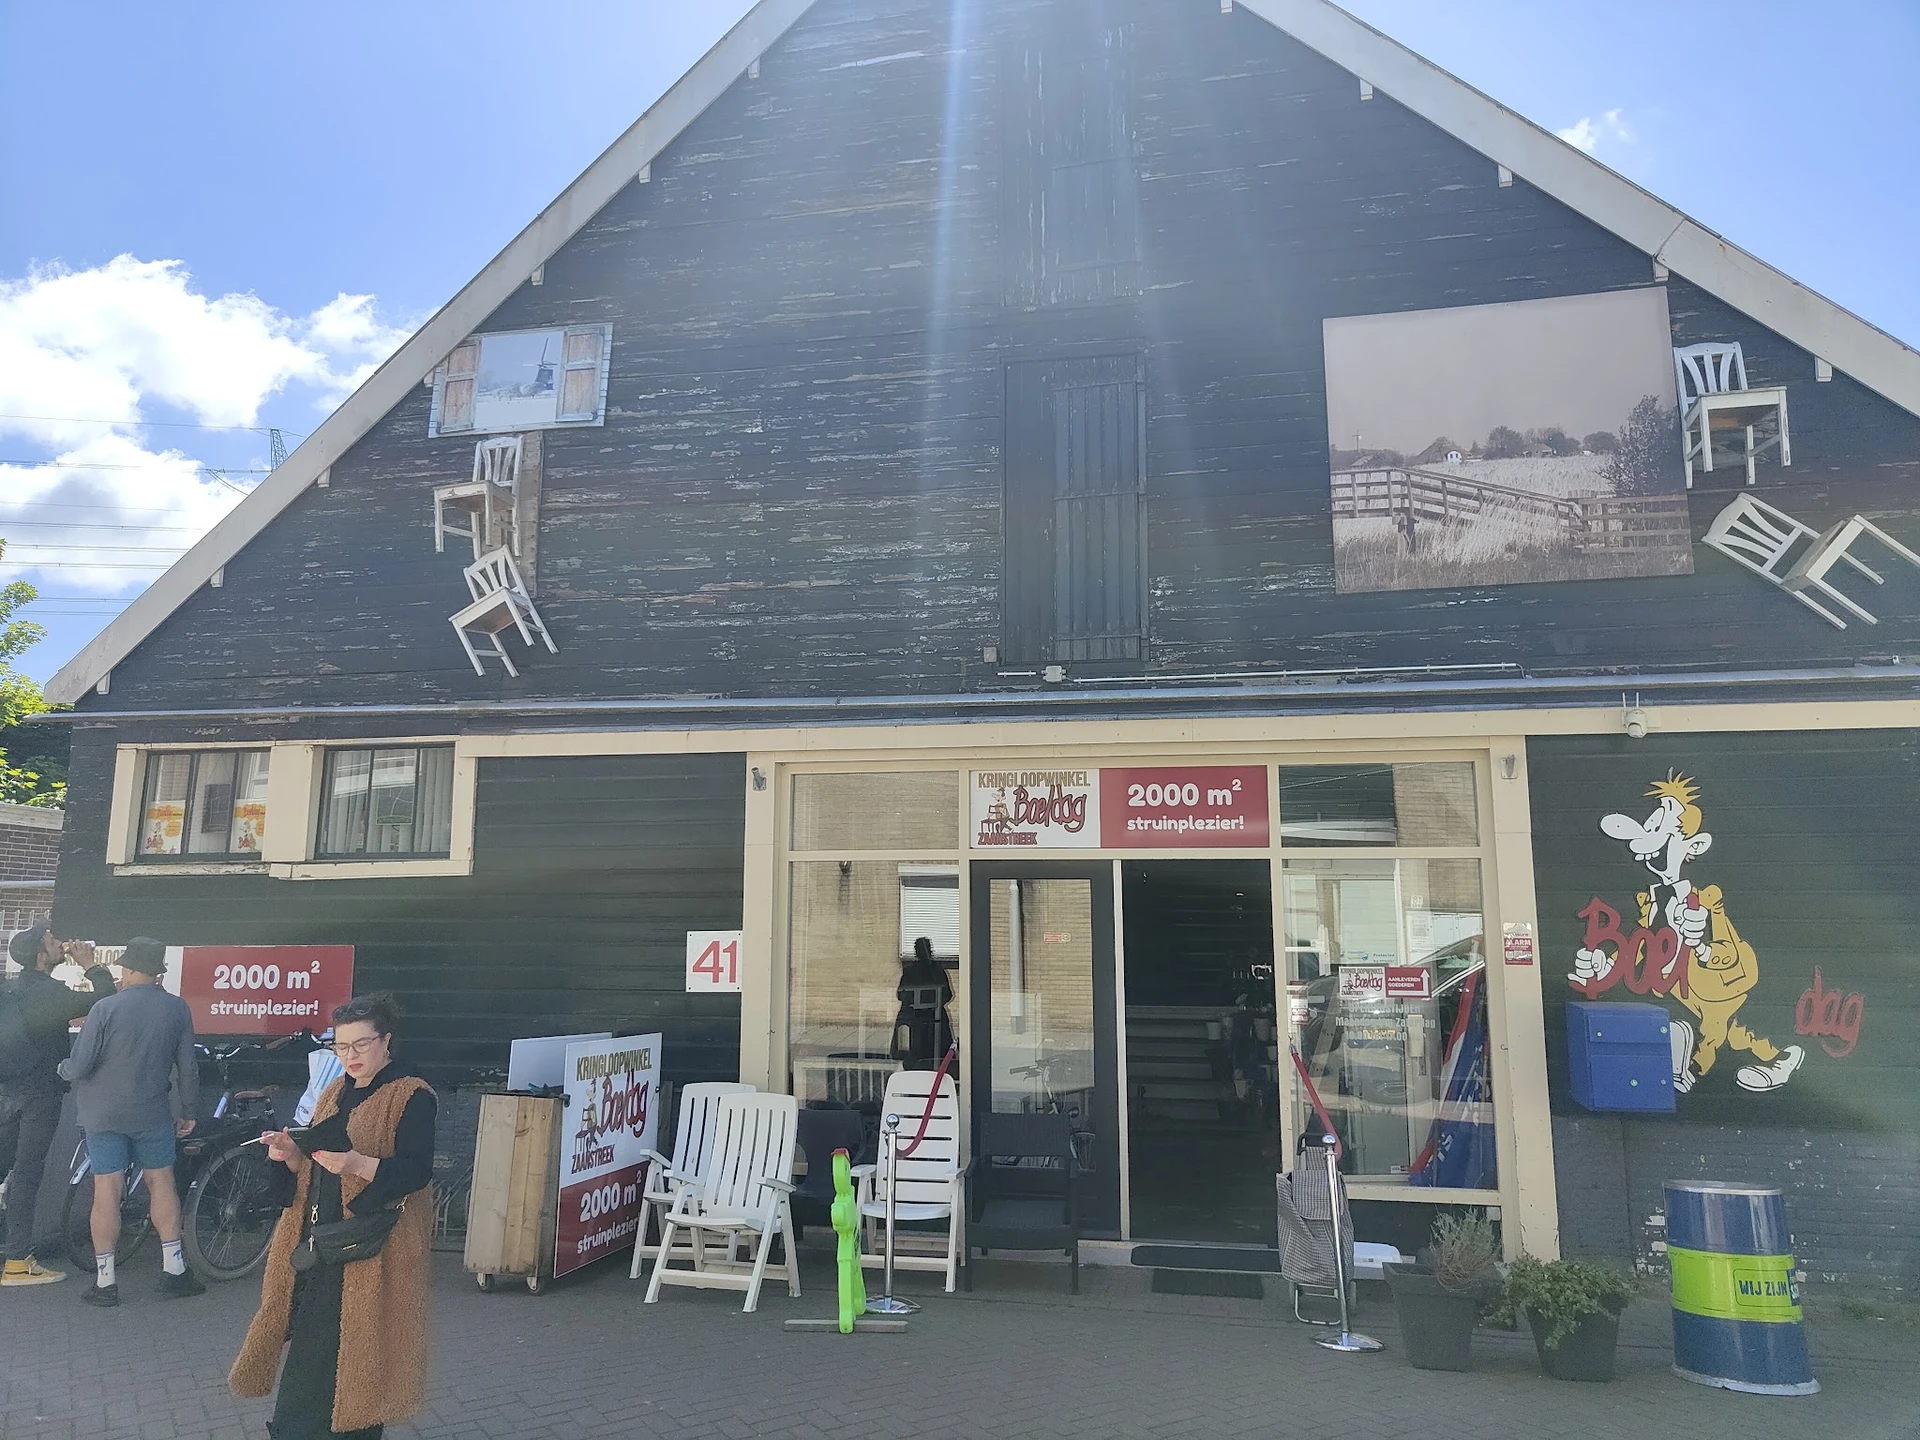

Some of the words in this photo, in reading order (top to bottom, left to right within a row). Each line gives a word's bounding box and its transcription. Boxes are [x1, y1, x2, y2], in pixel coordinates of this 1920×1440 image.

[978, 771, 1091, 788] KRINGLOOPWINKEL
[1127, 783, 1200, 807] 2000
[1206, 778, 1242, 806] m²
[977, 831, 1039, 846] ZAANSTREEK
[1126, 815, 1245, 834] struinplezier!
[213, 963, 281, 990] 2000
[286, 960, 321, 989] m²
[692, 940, 738, 983] 41
[210, 1000, 319, 1019] struinplezier!
[1795, 964, 1866, 1059] dag
[576, 1047, 652, 1081] KRINGLOOPWINKEL
[571, 1144, 616, 1174] ZAANSTREEK
[579, 1182, 621, 1222] 2000
[577, 1214, 640, 1254] struinplezier
[1738, 1280, 1763, 1296] WIJ
[1764, 1281, 1788, 1297] ZIJN
